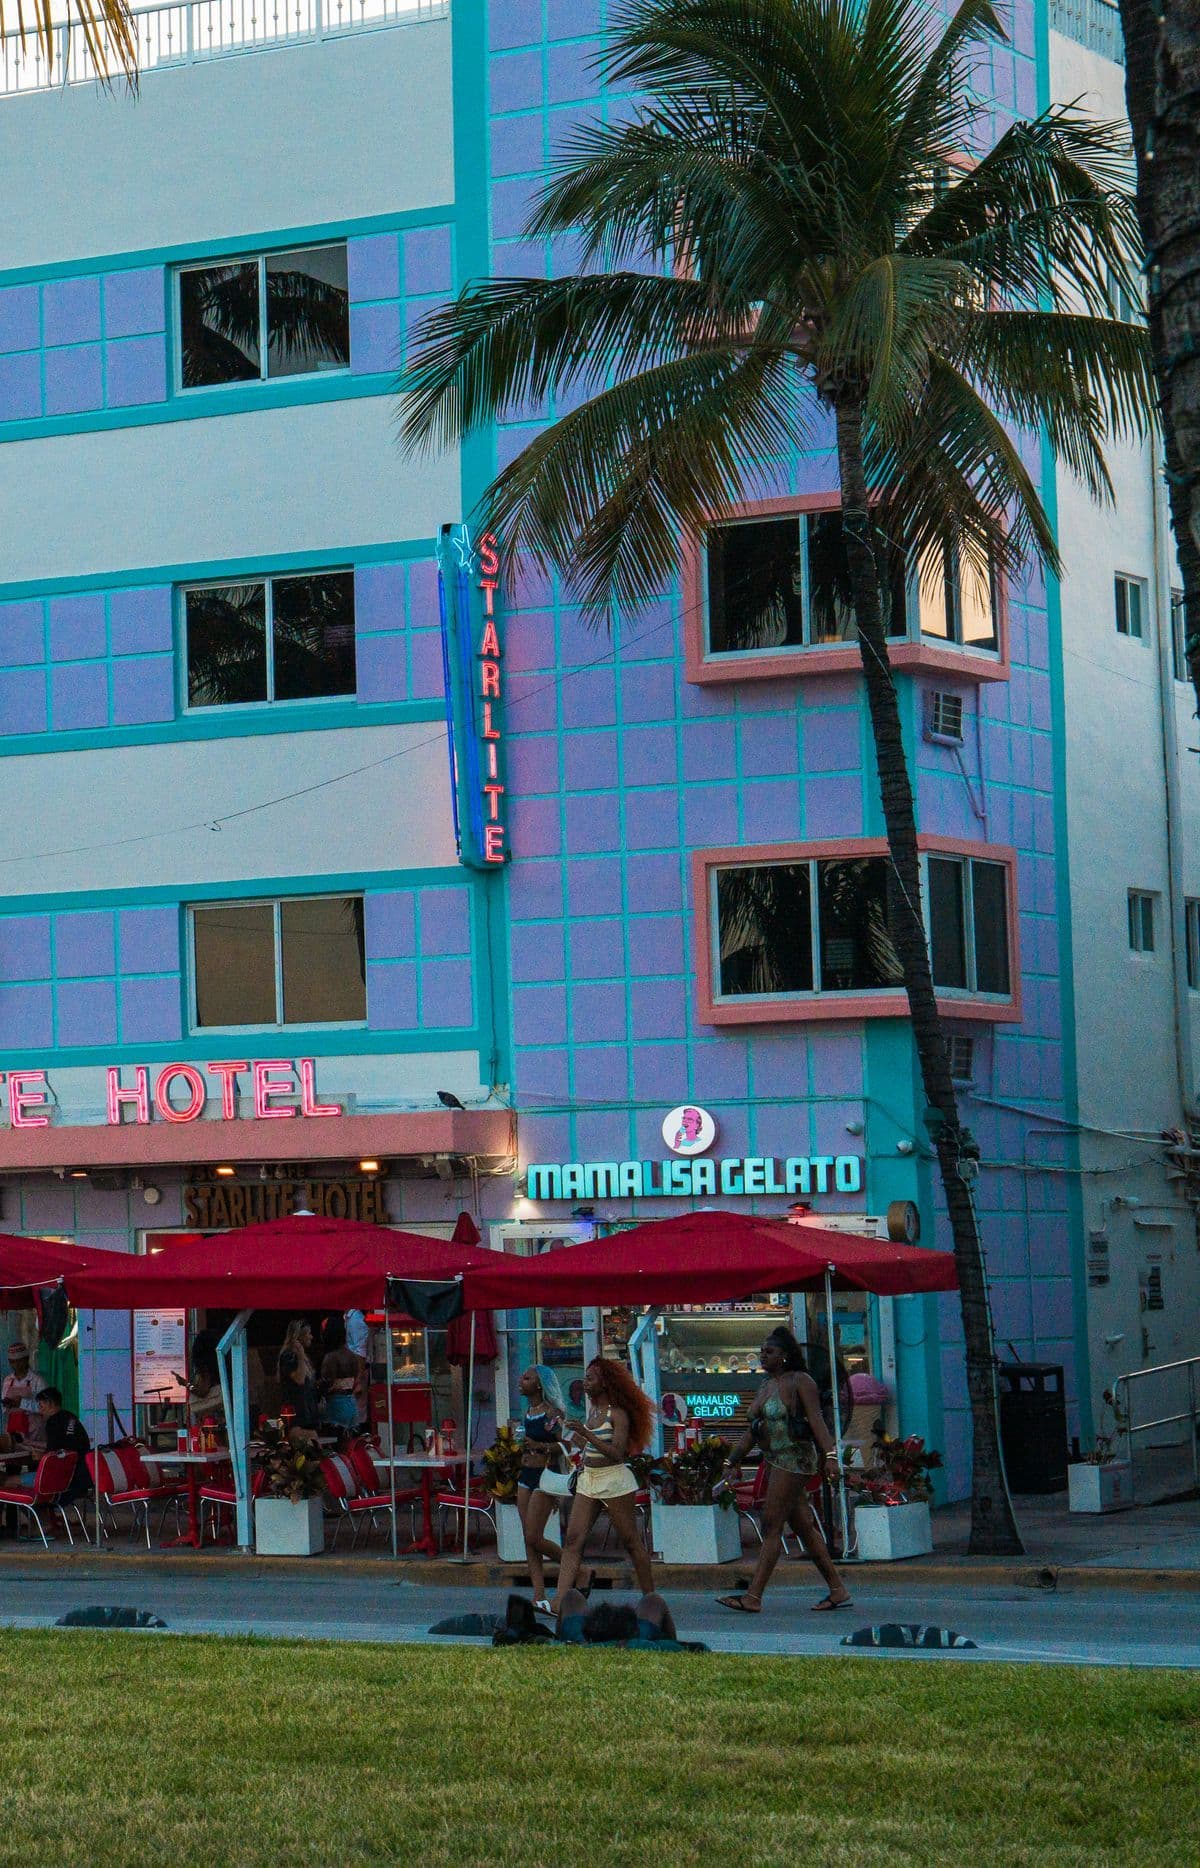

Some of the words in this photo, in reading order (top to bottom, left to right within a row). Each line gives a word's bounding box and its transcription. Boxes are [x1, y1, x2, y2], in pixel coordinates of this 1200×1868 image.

[479, 533, 504, 862] STARLITE
[107, 1059, 342, 1125] HOTEL
[527, 1159, 716, 1200] MAMALISA
[721, 1155, 862, 1196] GELATO
[184, 1183, 297, 1228] STARLITE
[304, 1180, 392, 1223] HOTEL
[686, 1394, 740, 1405] MAMALISA
[694, 1406, 734, 1417] GELATO
